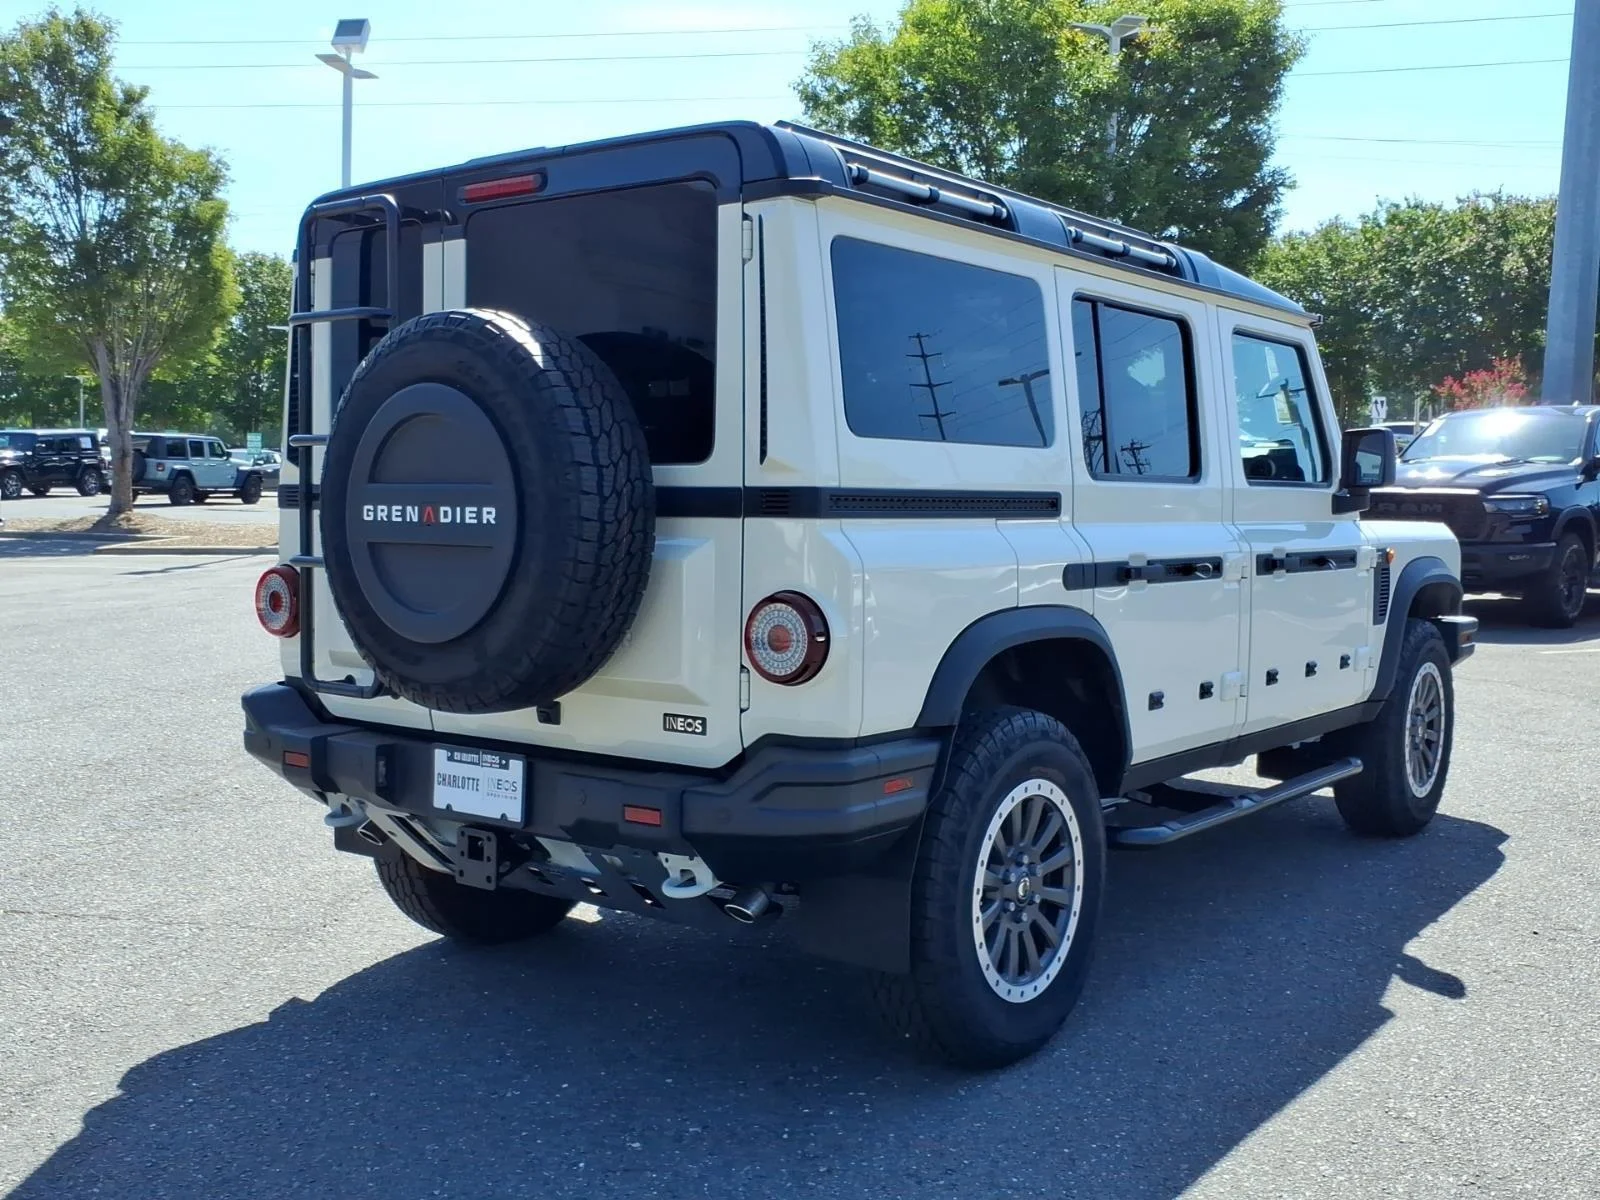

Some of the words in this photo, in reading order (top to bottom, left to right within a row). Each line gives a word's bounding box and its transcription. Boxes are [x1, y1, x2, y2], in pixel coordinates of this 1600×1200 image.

[363, 504, 496, 524] GRENADIER
[1378, 502, 1442, 513] RAM
[666, 716, 703, 733] INEOS
[437, 772, 480, 792] CHARLOTTE
[488, 777, 517, 792] INEOS
